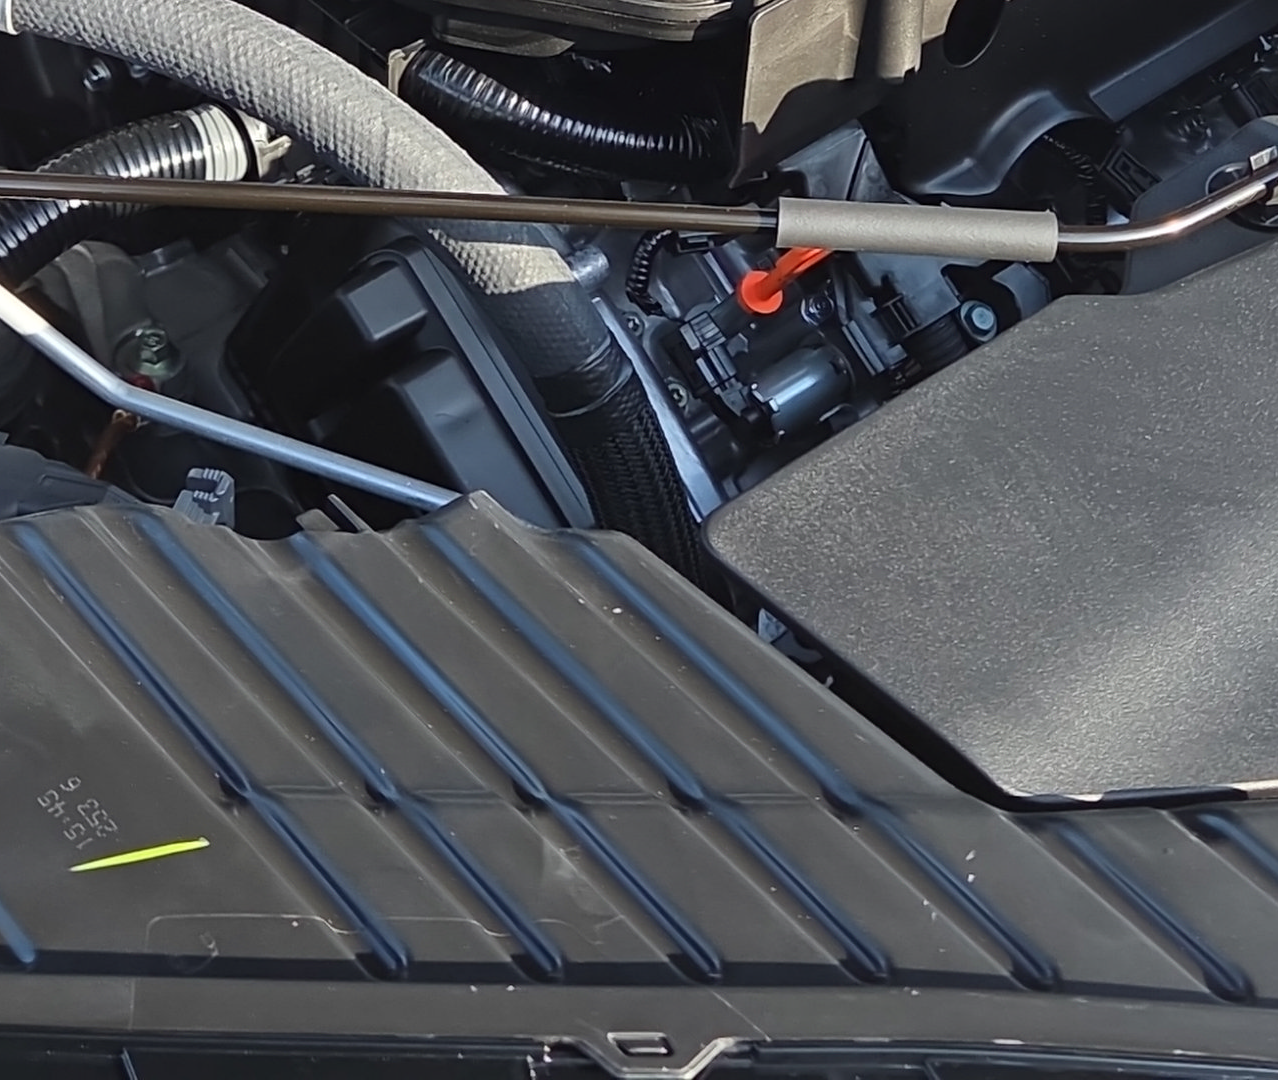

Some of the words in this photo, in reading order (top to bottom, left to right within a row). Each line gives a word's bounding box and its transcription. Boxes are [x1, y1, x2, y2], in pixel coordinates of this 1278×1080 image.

[60, 776, 82, 792] 6
[37, 789, 94, 851] 15:45
[77, 799, 118, 838] 253
